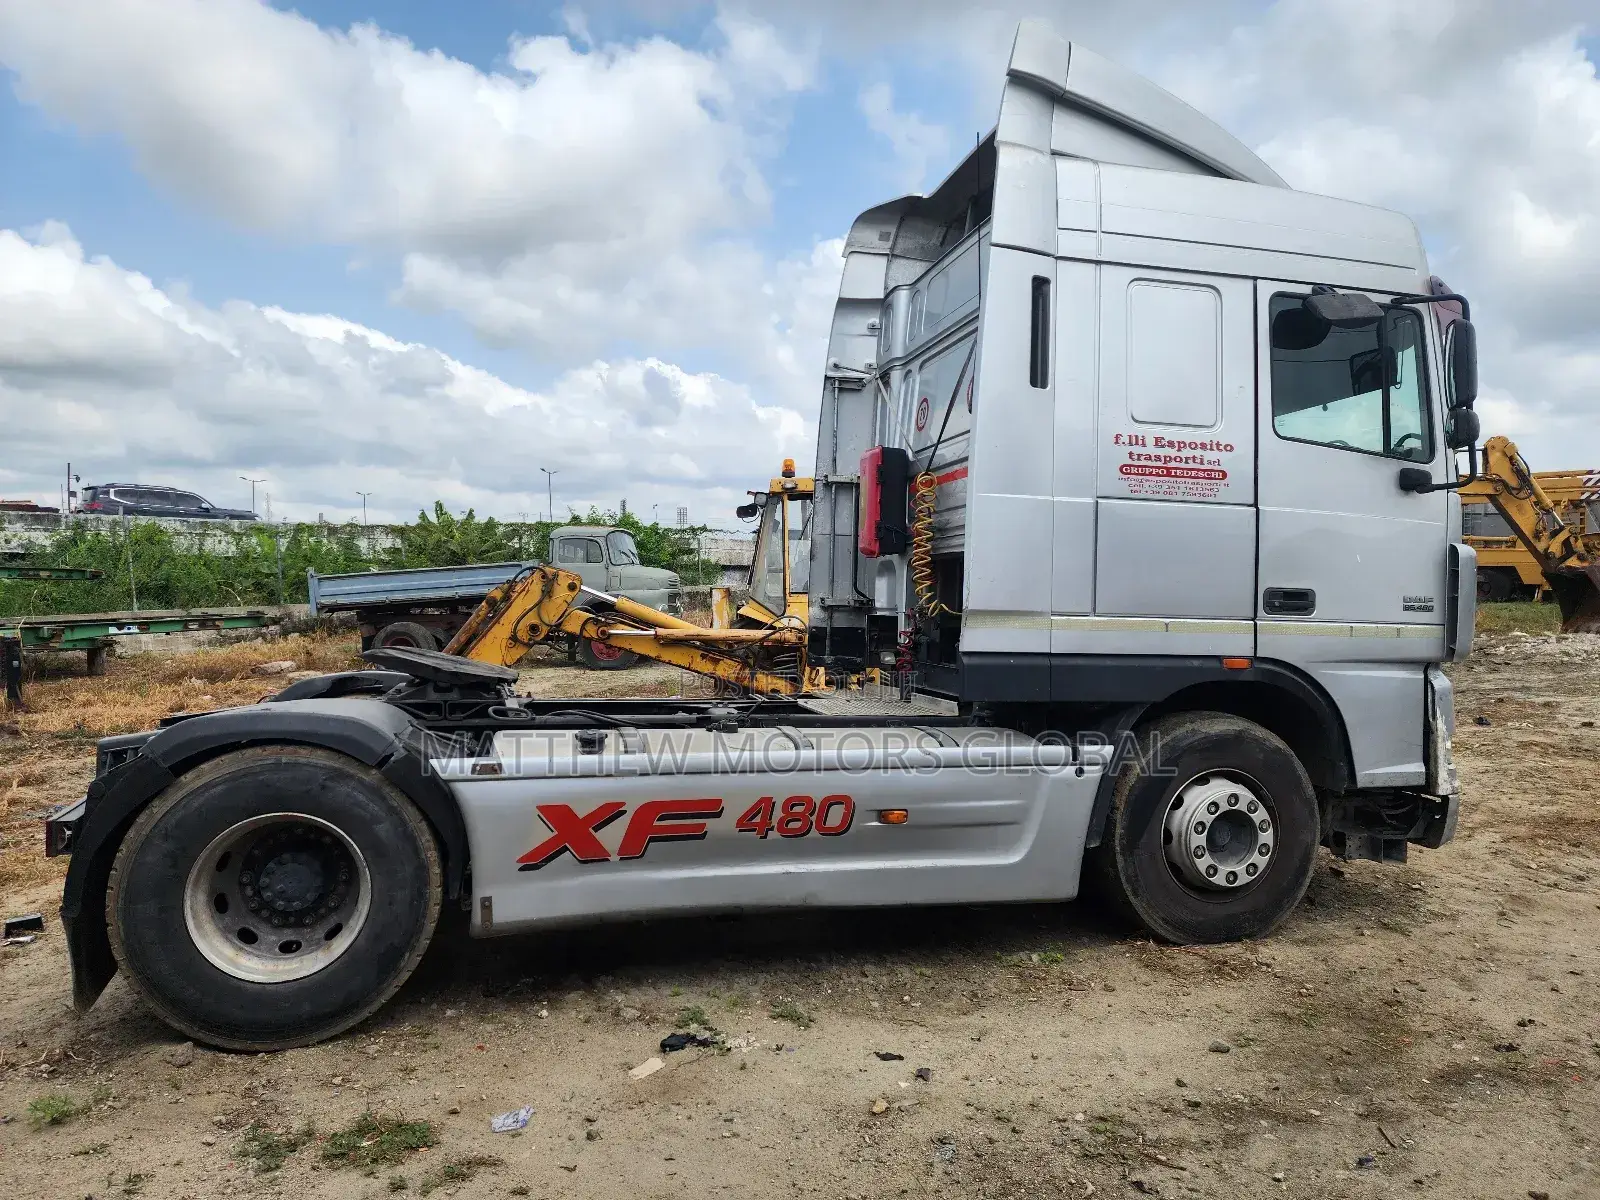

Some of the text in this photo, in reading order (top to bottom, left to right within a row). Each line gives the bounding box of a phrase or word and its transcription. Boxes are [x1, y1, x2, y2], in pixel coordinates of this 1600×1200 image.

[1114, 433, 1235, 452] f.lli Esposito
[1128, 450, 1206, 466] trasporti
[1122, 466, 1223, 479] GRUPPO TEDESCHI
[516, 794, 856, 872] XF 480
